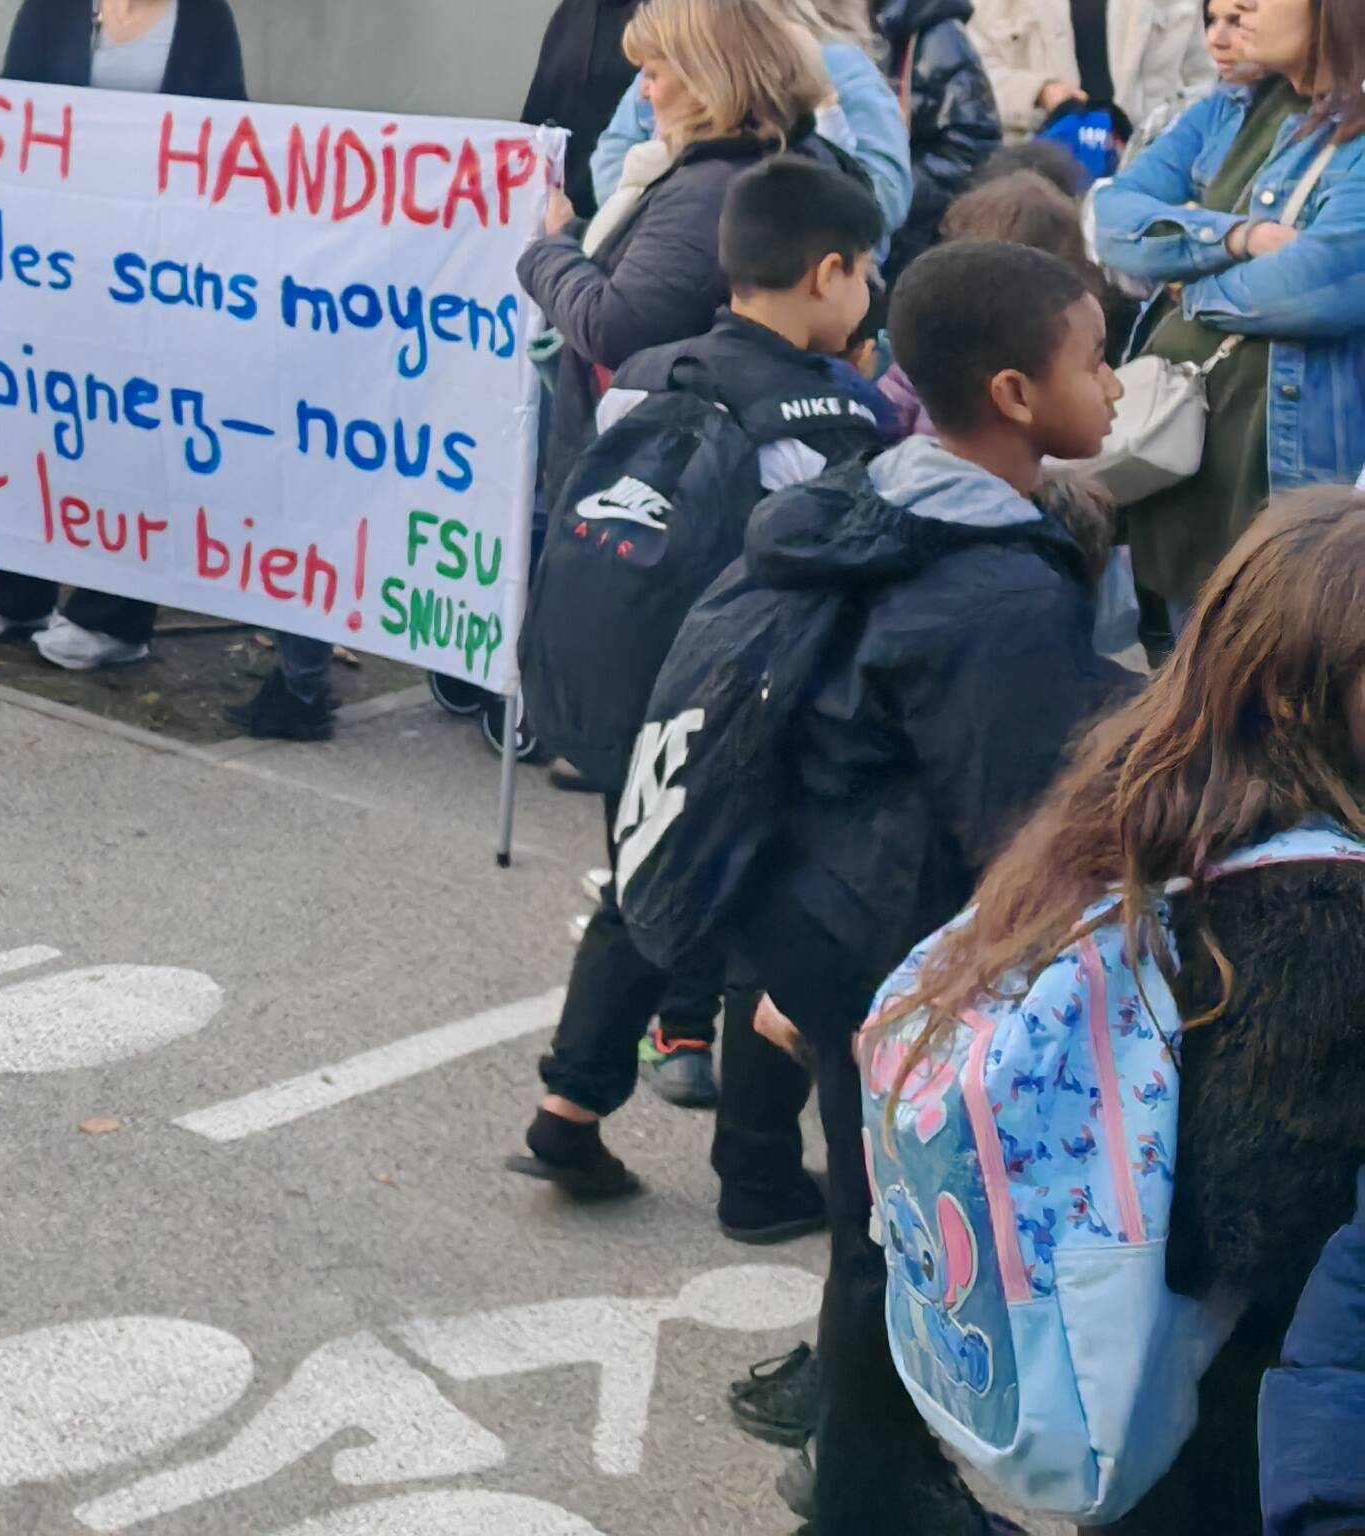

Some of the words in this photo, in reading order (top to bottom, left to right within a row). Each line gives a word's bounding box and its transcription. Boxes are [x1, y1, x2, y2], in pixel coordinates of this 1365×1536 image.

[108, 252, 258, 320] sans
[281, 274, 519, 379] moyens
[779, 396, 842, 421] NIKE
[36, 450, 167, 560] leur
[407, 510, 502, 586] FSU
